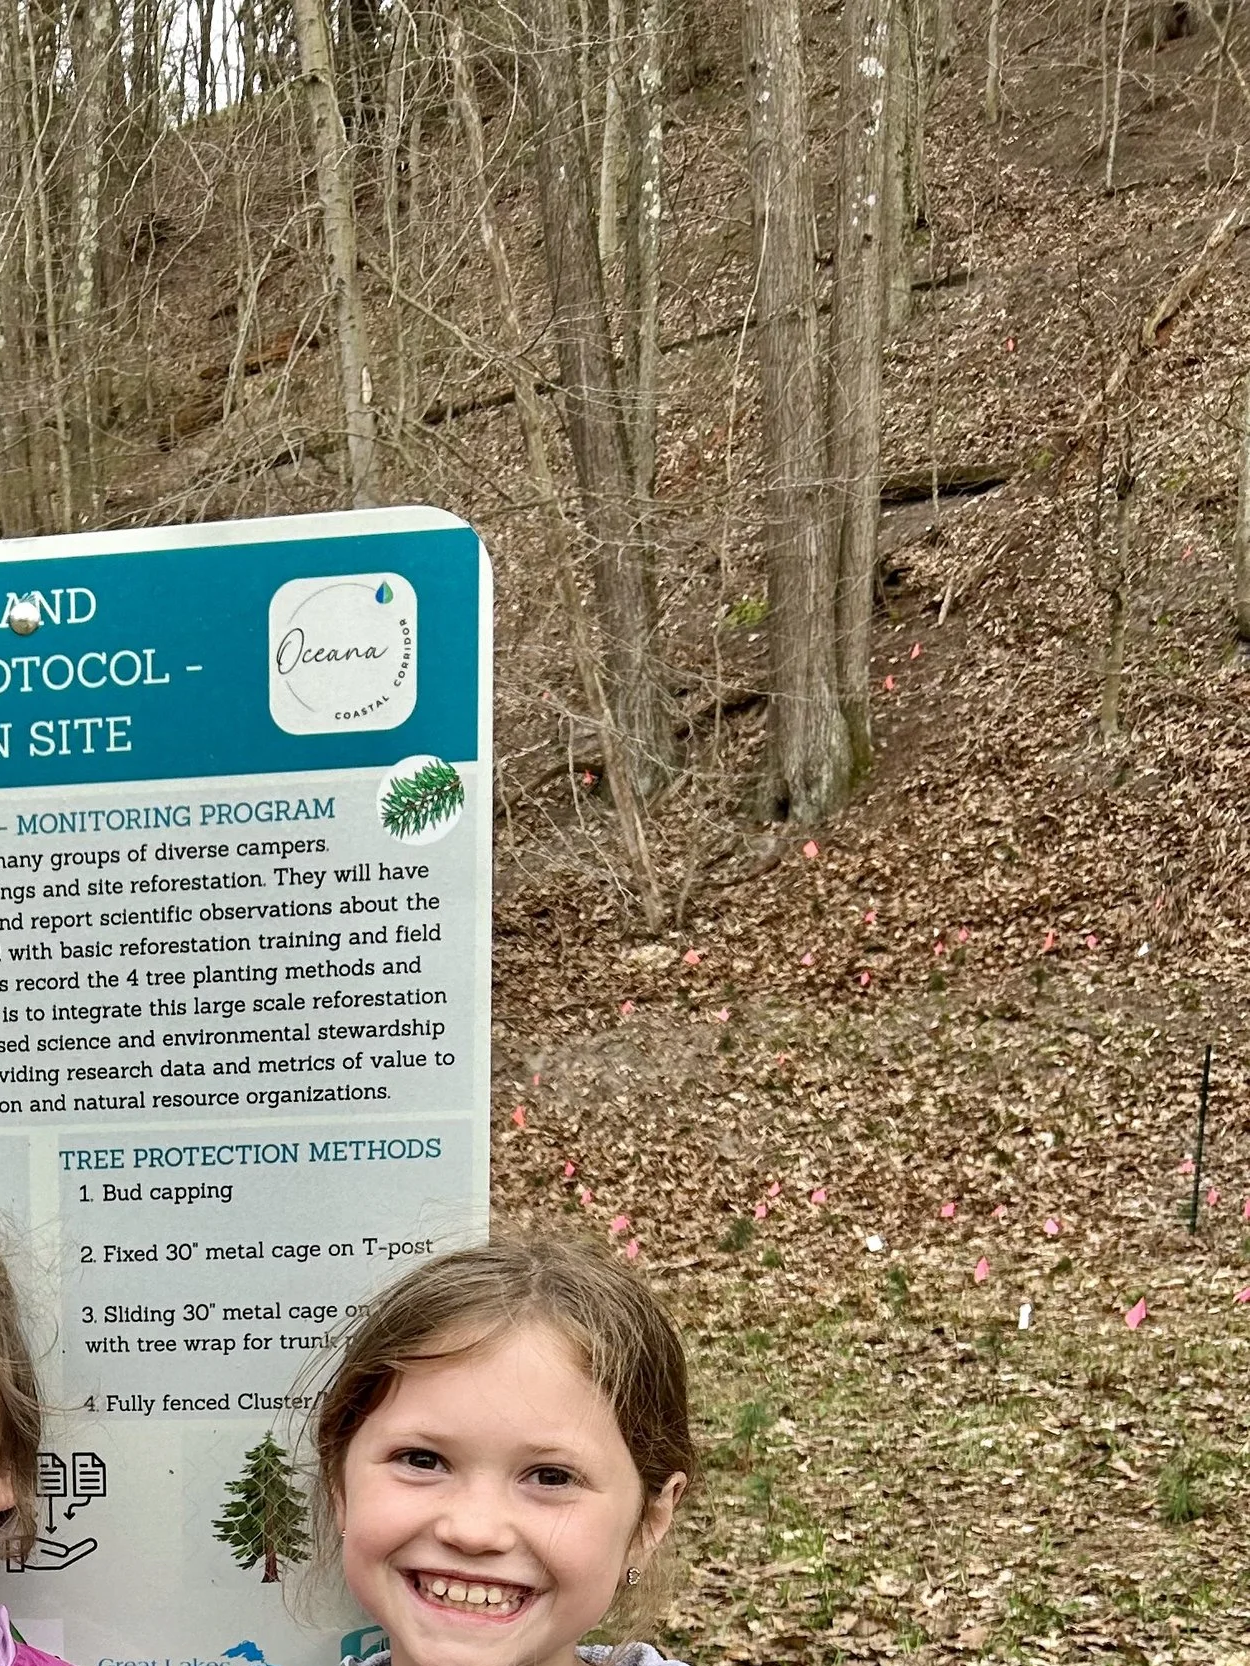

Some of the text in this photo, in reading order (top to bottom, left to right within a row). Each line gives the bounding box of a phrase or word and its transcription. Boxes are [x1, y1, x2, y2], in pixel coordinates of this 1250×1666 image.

[276, 627, 390, 675] Oceana
[334, 618, 412, 720] COASTAL CORRIDOR
[29, 715, 132, 757] SITE
[16, 804, 191, 836] MONITORING
[199, 797, 336, 826] PROGRAM
[50, 850, 120, 872] groups
[127, 843, 148, 863] of
[155, 842, 229, 861] diverse
[236, 839, 329, 859] campers.
[43, 878, 81, 898] and
[87, 878, 123, 896] site
[130, 872, 266, 894] reforestation.
[273, 867, 327, 890] They
[333, 863, 371, 883] will
[378, 862, 429, 881] have
[30, 911, 93, 934] report
[100, 905, 192, 926] scientific
[199, 900, 332, 921] observations
[339, 895, 399, 914] about
[406, 892, 440, 911] the
[8, 942, 53, 961] with
[59, 941, 113, 959] basic
[119, 935, 251, 956] reforestation
[258, 930, 341, 952] training
[348, 925, 388, 945] and
[395, 923, 442, 943] field
[15, 971, 80, 992] record
[87, 970, 119, 988] the
[126, 968, 139, 987] 4
[146, 970, 186, 986] tree
[193, 965, 278, 989] planting
[285, 958, 375, 980] methods
[382, 955, 422, 975] and
[2, 1006, 19, 1023] is
[25, 1006, 45, 1022] to
[52, 1002, 142, 1024] integrate
[149, 998, 187, 1017] this
[194, 997, 246, 1019] large
[253, 992, 305, 1012] scale
[312, 988, 448, 1009] reforestation
[37, 1034, 111, 1052] science
[118, 1029, 155, 1049] and
[162, 1023, 311, 1047] environmental
[318, 1018, 445, 1041] stewardship
[67, 1060, 153, 1081] research
[160, 1059, 206, 1077] data
[213, 1056, 251, 1075] and
[258, 1055, 335, 1074] metrics
[342, 1051, 364, 1070] of
[370, 1050, 427, 1069] value
[434, 1051, 455, 1066] to
[30, 1093, 67, 1113] and
[73, 1091, 146, 1111] natural
[152, 1092, 240, 1108] resource
[246, 1084, 391, 1109] organizations.
[58, 1138, 442, 1171] TREE PROTECTION METHODS
[79, 1182, 234, 1205] 1. Bud capping
[80, 1237, 434, 1264] 2. Fixed 30" metal cage on T-post
[81, 1307, 97, 1324] 3.
[104, 1304, 176, 1326] Sliding
[183, 1302, 217, 1321] 30"
[222, 1301, 282, 1321] metal
[288, 1305, 338, 1324] cage
[85, 1335, 130, 1354] with
[137, 1337, 177, 1352] tree
[183, 1338, 236, 1356] wrap
[243, 1333, 273, 1351] for
[280, 1331, 337, 1350] trunk
[84, 1395, 100, 1412] 4.
[106, 1395, 154, 1416] Fully
[162, 1393, 231, 1411] fenced
